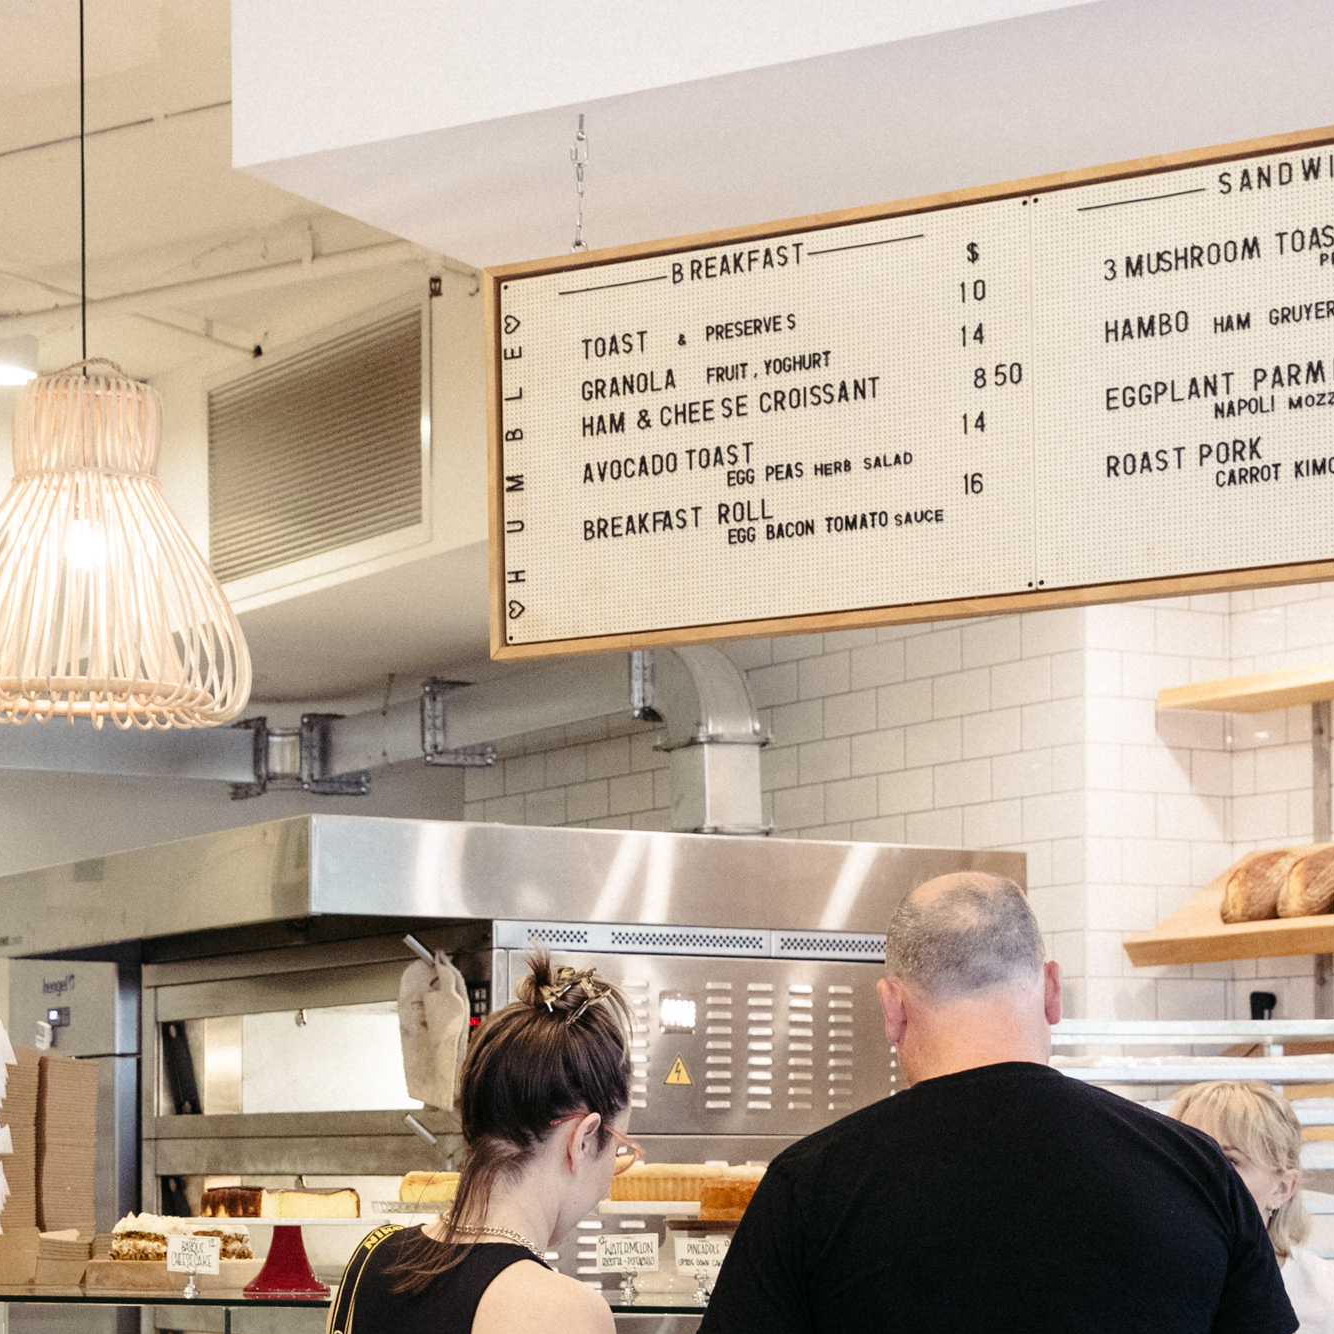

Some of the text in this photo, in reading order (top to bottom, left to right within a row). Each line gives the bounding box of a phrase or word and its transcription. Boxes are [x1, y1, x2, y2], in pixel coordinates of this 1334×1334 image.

[672, 242, 979, 285] BREAKFAST $
[1104, 259, 1117, 281] 3
[1125, 236, 1261, 278] MUSHROOM
[581, 279, 986, 360] TOAST & PRESERVES 10
[1105, 310, 1189, 343] HAMBO
[1213, 312, 1251, 334] HAM
[581, 368, 676, 402] GRANOLA
[764, 350, 831, 375] YOGHURT
[961, 323, 984, 347] 14
[582, 411, 625, 437] HAM
[636, 409, 652, 430] &
[660, 394, 748, 427] CHEESE
[759, 376, 880, 414] CROISSANT
[1106, 372, 1234, 411] EGGPLANT
[1214, 395, 1275, 419] NAPOLI
[583, 411, 986, 484] AVOCADO TOAST 14
[1106, 446, 1186, 478] ROAST
[1199, 436, 1262, 466] PORK
[726, 451, 913, 487] EGG PEAS HERB SALAD
[1215, 462, 1282, 488] CARROT
[583, 472, 983, 541] BREAKFAST ROLL 16
[727, 509, 944, 545] EGG BACON TOMATO SAUCE
[604, 1241, 654, 1256] WATERMELON
